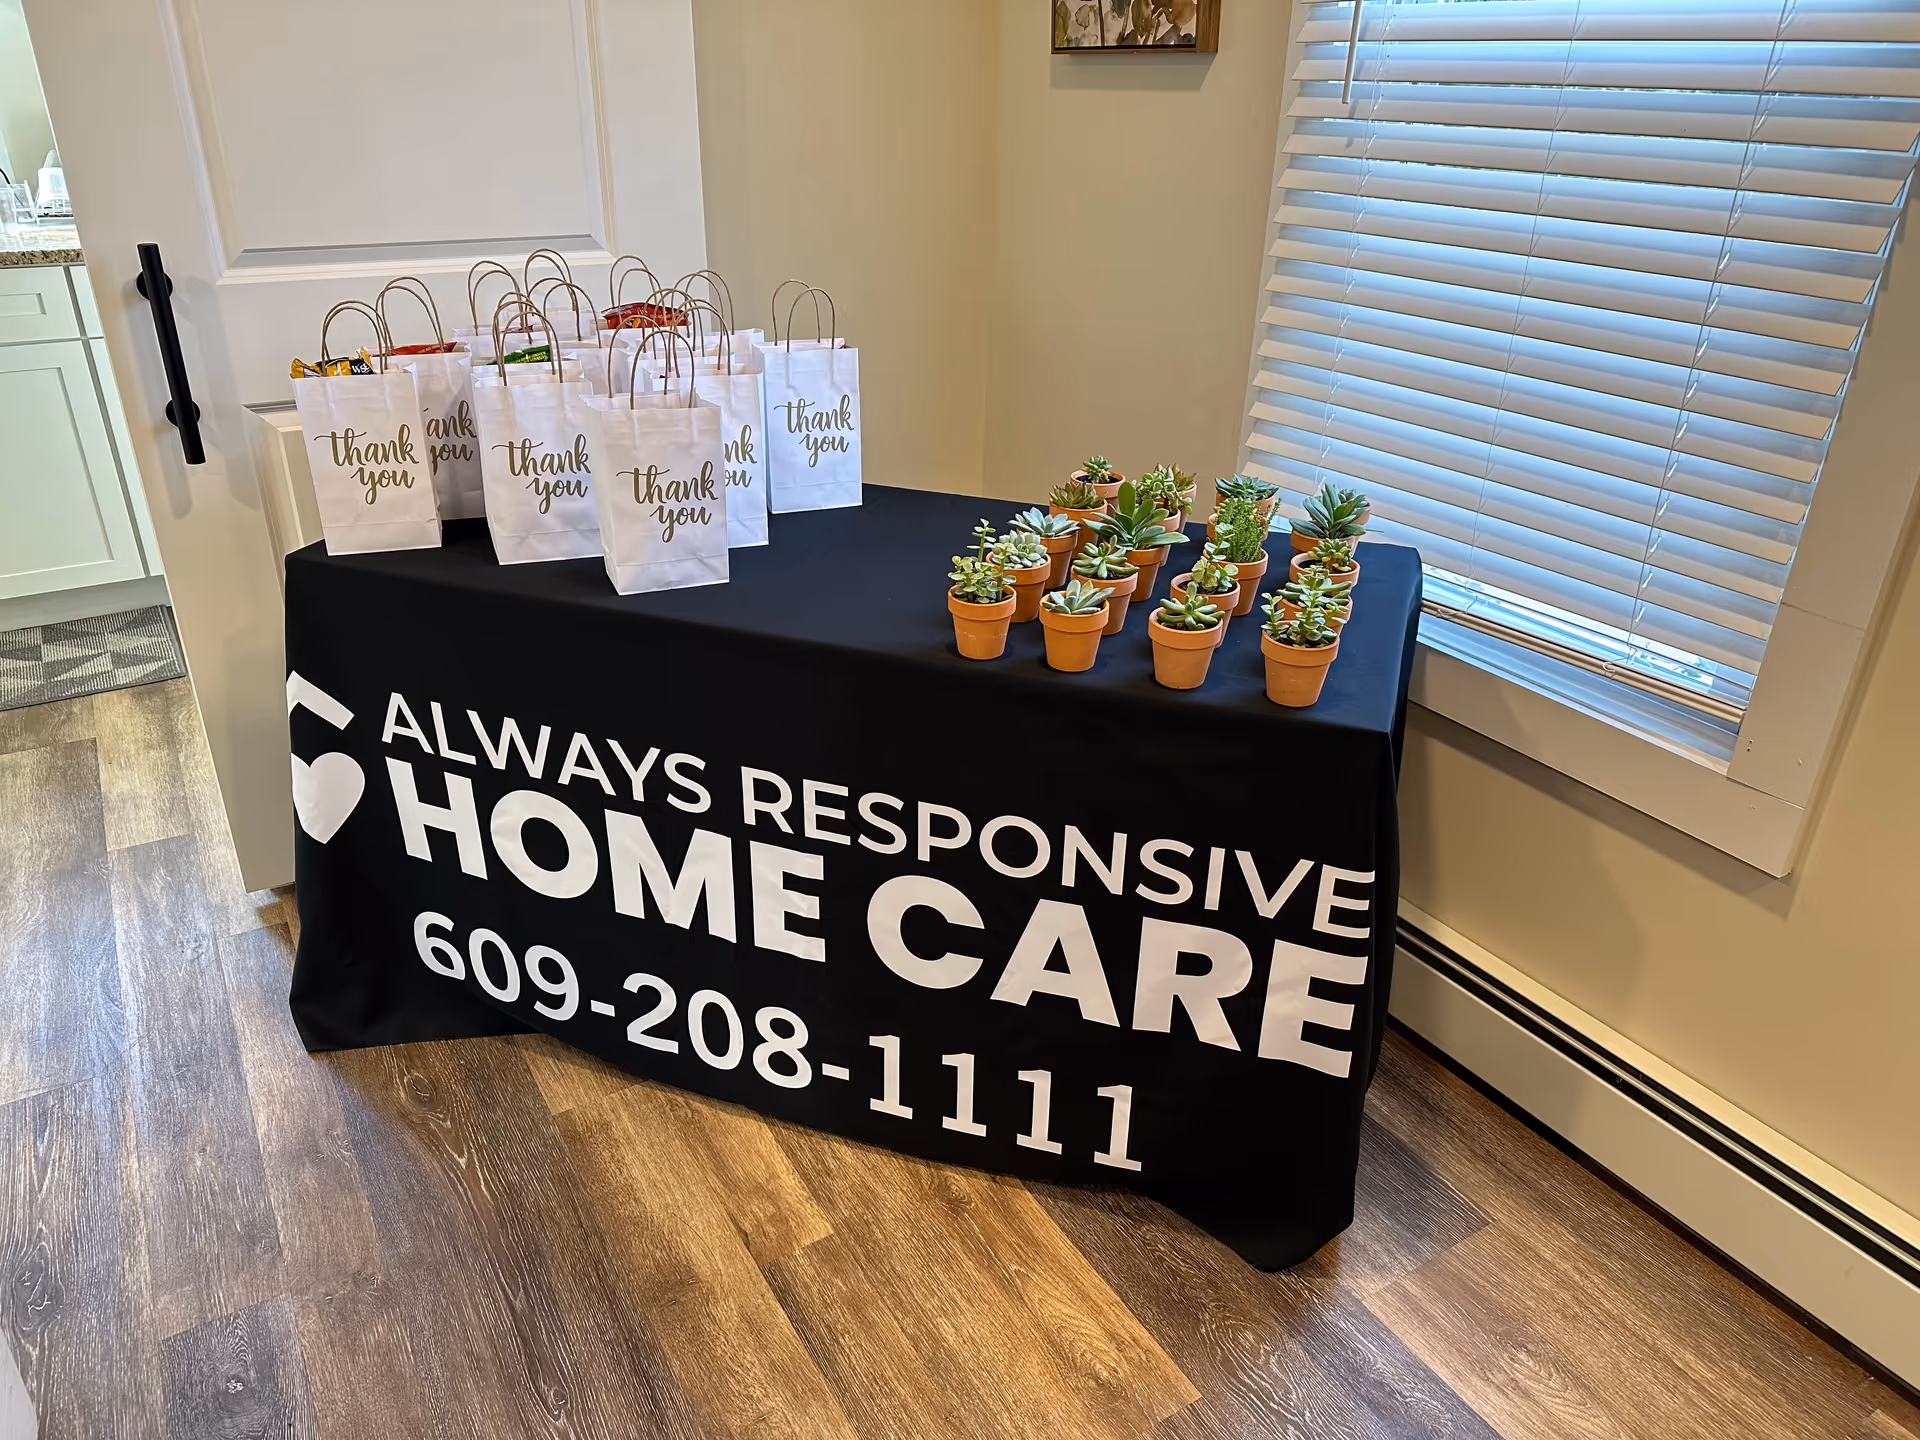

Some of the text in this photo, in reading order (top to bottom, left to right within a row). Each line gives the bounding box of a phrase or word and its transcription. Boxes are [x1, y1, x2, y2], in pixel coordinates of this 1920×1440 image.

[425, 400, 478, 439] ank
[772, 394, 855, 434] thank
[313, 423, 420, 467] thank
[491, 433, 592, 477] thank
[798, 433, 850, 468] you
[350, 466, 416, 505] you
[525, 476, 589, 515] you
[615, 460, 719, 505] thank
[649, 504, 713, 544] you
[381, 691, 1376, 939] ALWAYS RESPONSIVE
[384, 756, 1369, 1079] HOME CARE
[413, 911, 1142, 1172] 609-208-1111
